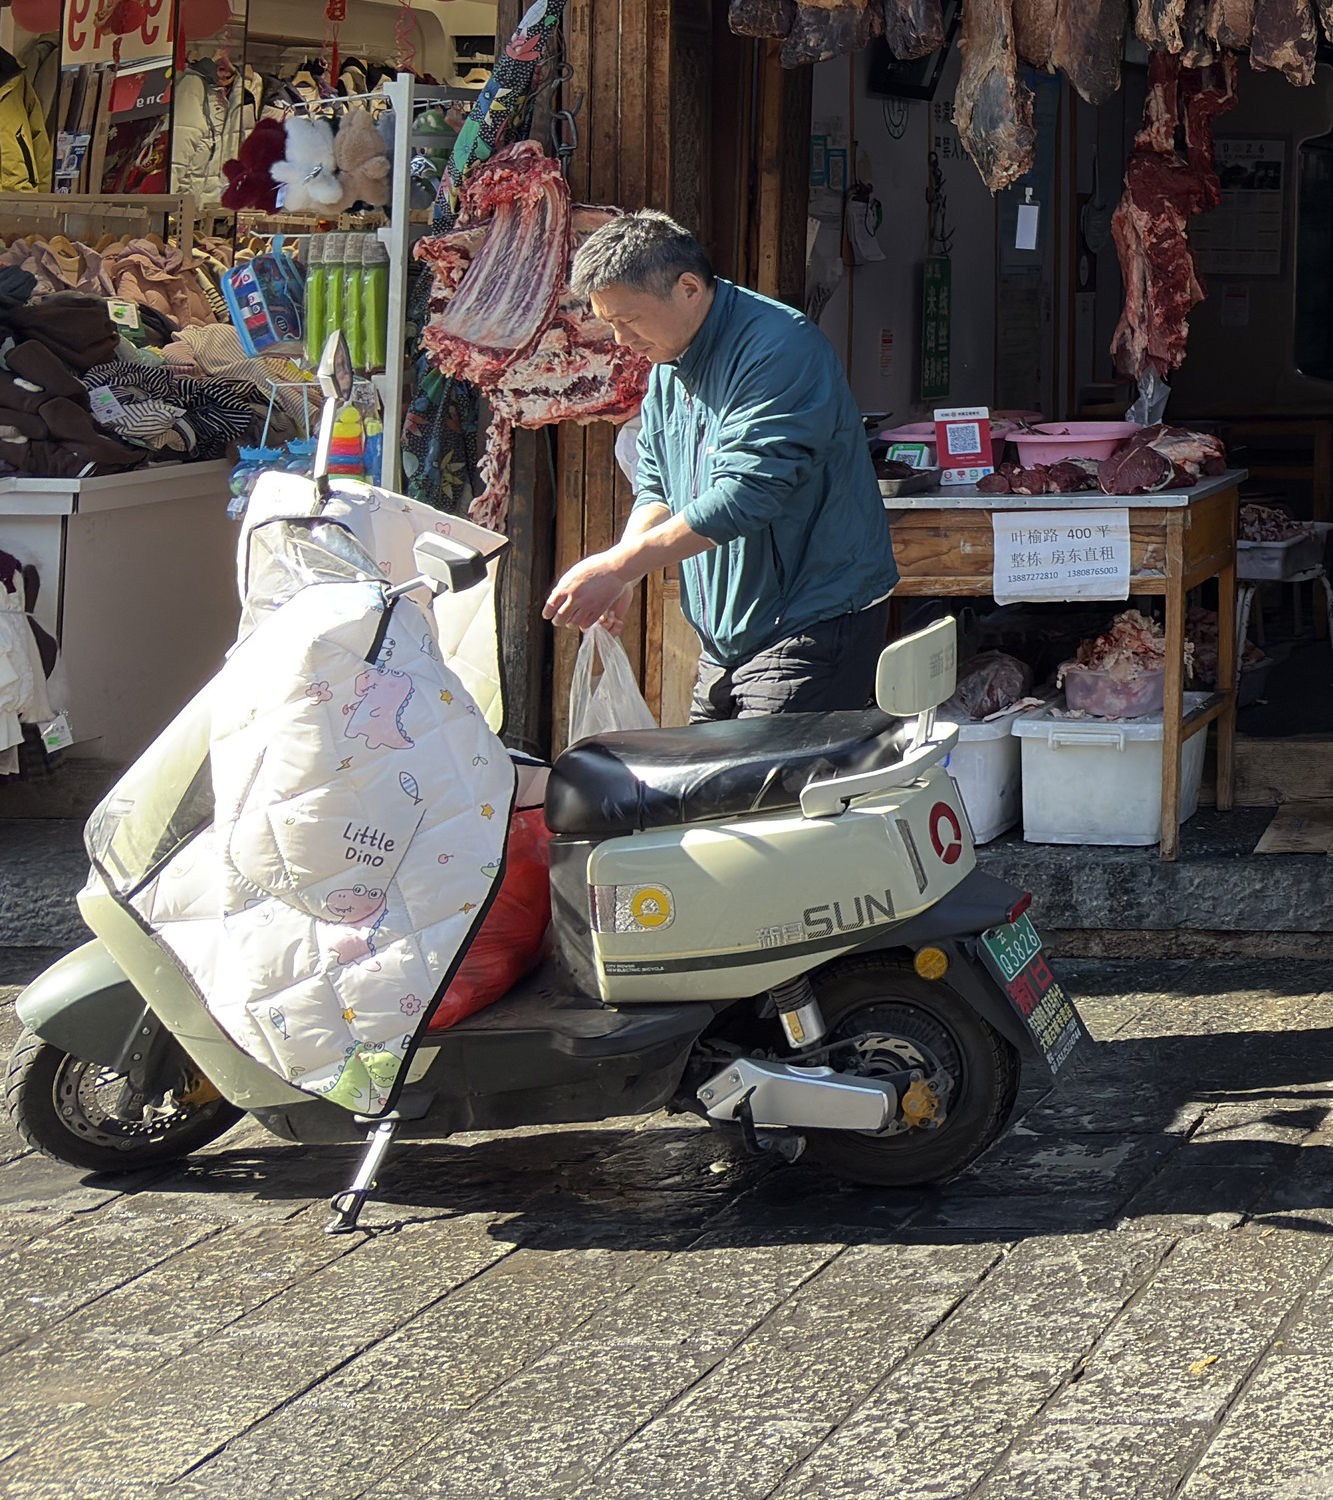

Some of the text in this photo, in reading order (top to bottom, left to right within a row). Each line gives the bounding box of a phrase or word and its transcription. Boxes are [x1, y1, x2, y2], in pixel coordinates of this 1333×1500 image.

[1011, 525, 1111, 545] 叶榆路 400 平
[1011, 546, 1115, 568] 整栋 房东直租
[1008, 567, 1118, 582] 13887272810 13808765003
[343, 822, 394, 852] Little
[345, 847, 384, 867] Dino
[803, 889, 896, 939] SUN
[1000, 927, 1038, 974] Q3826
